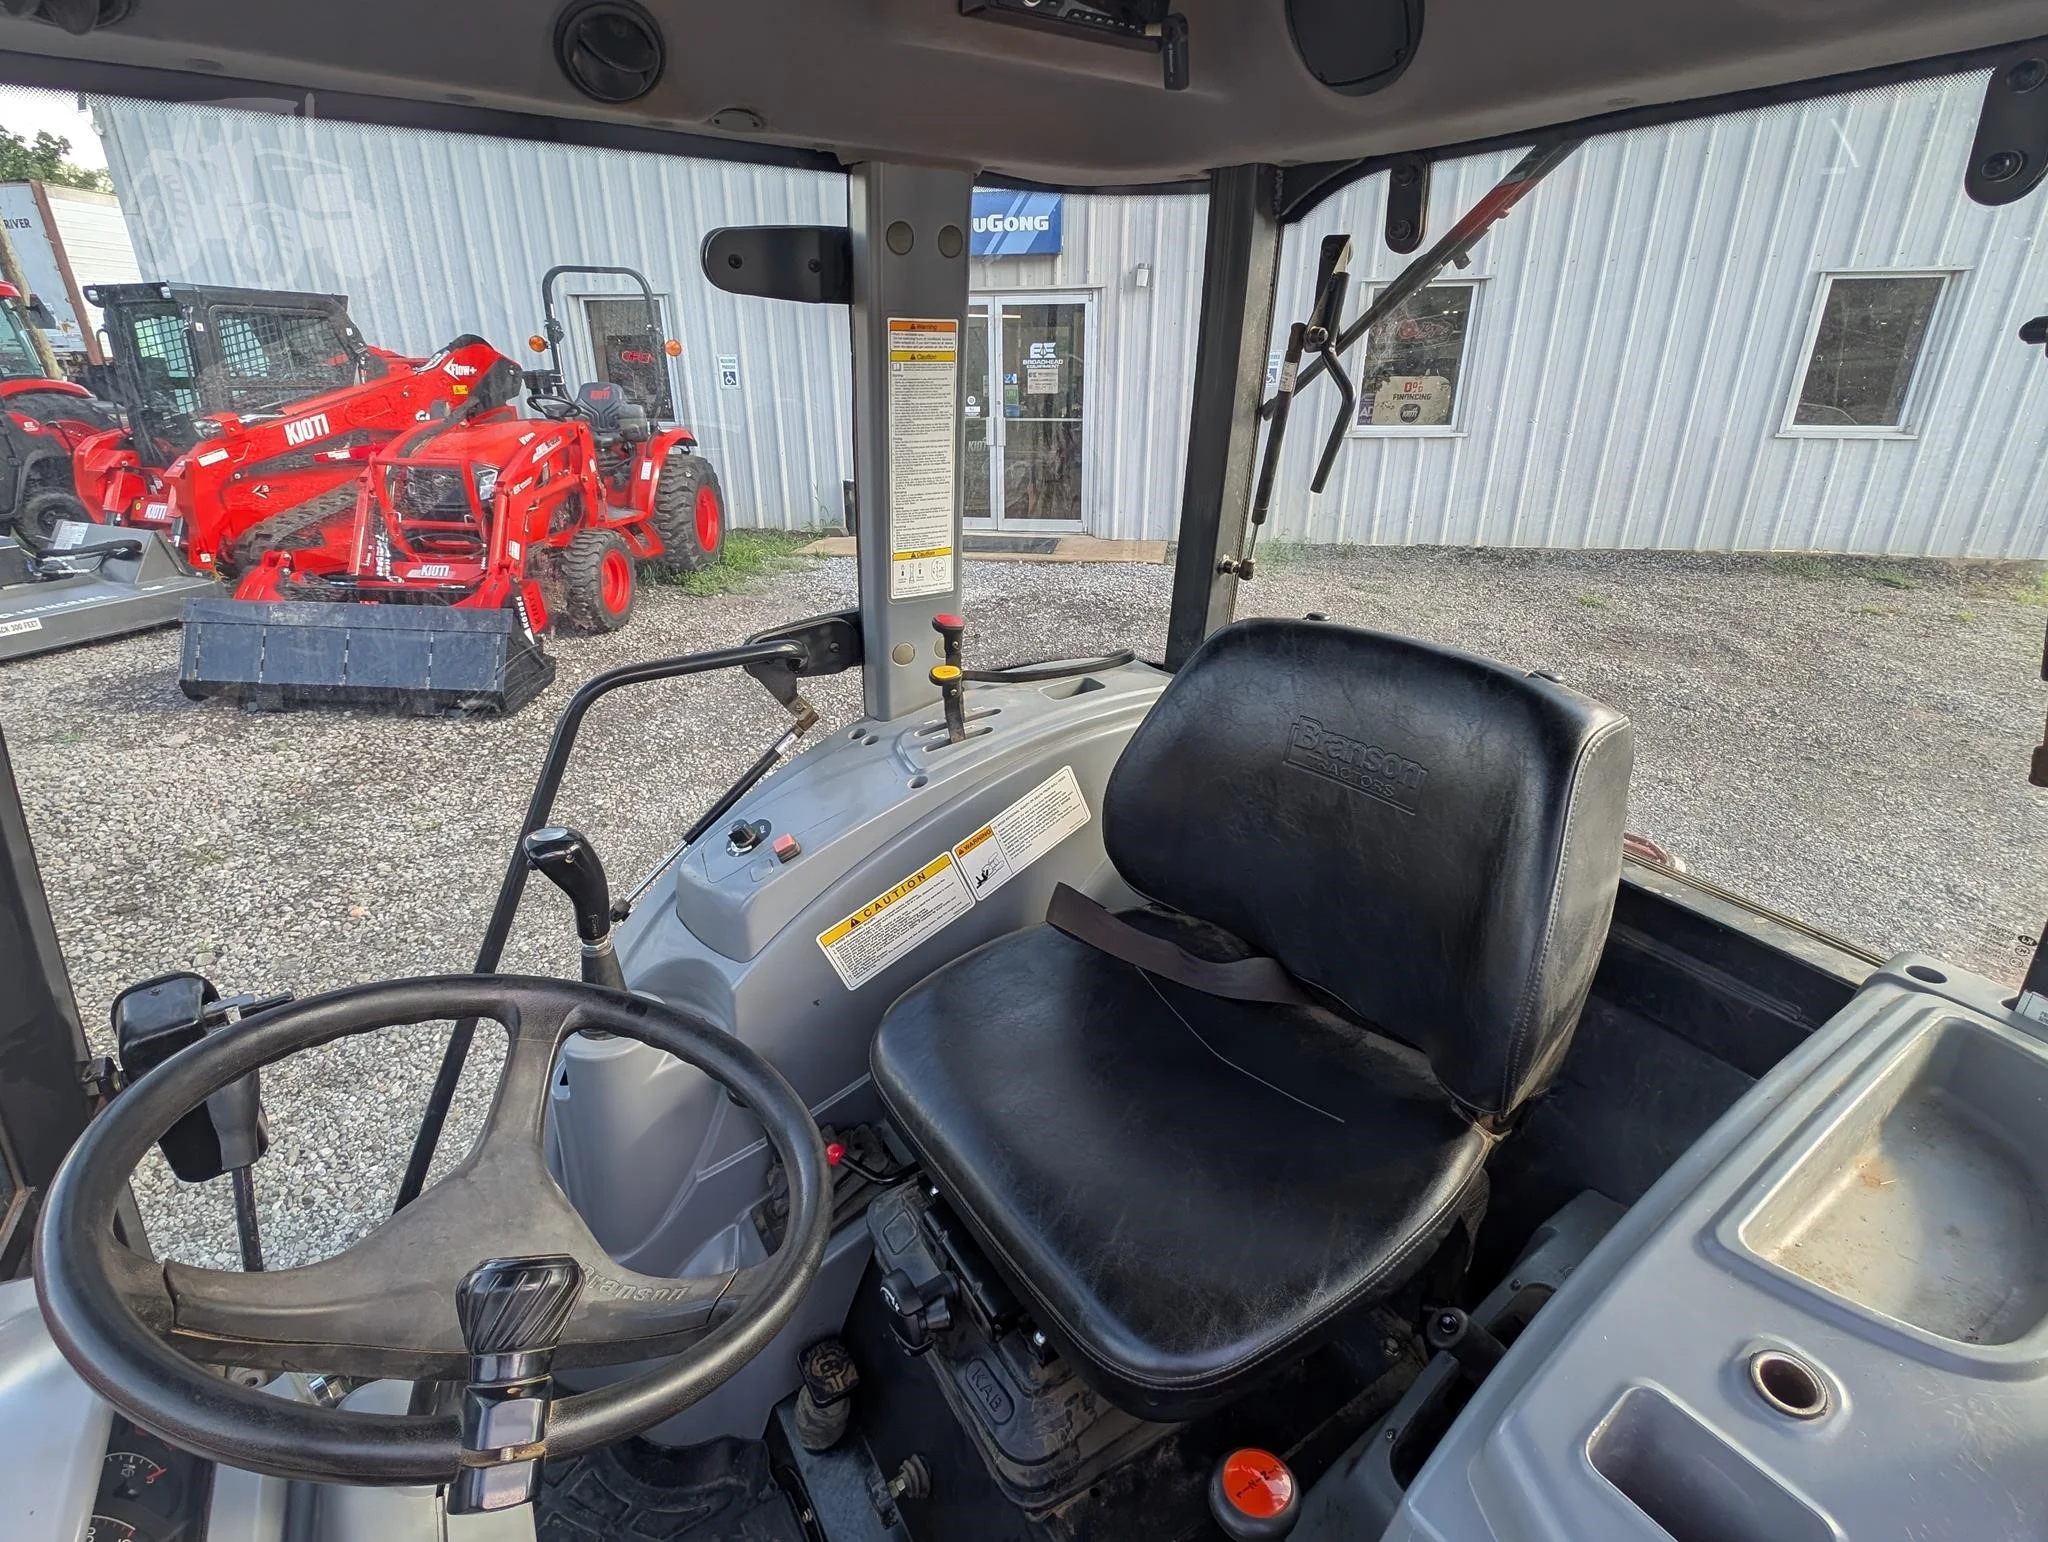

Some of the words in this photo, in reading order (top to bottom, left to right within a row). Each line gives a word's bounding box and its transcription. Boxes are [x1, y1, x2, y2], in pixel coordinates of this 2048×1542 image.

[3, 218, 32, 230] RIVER
[284, 413, 330, 447] KIOTI
[144, 503, 168, 520] KIOTI
[421, 564, 450, 577] KIOTI
[1294, 715, 1430, 790] Branson
[963, 829, 993, 852] WARNING
[863, 872, 926, 918] CAUTION
[971, 1367, 1002, 1413] KAB
